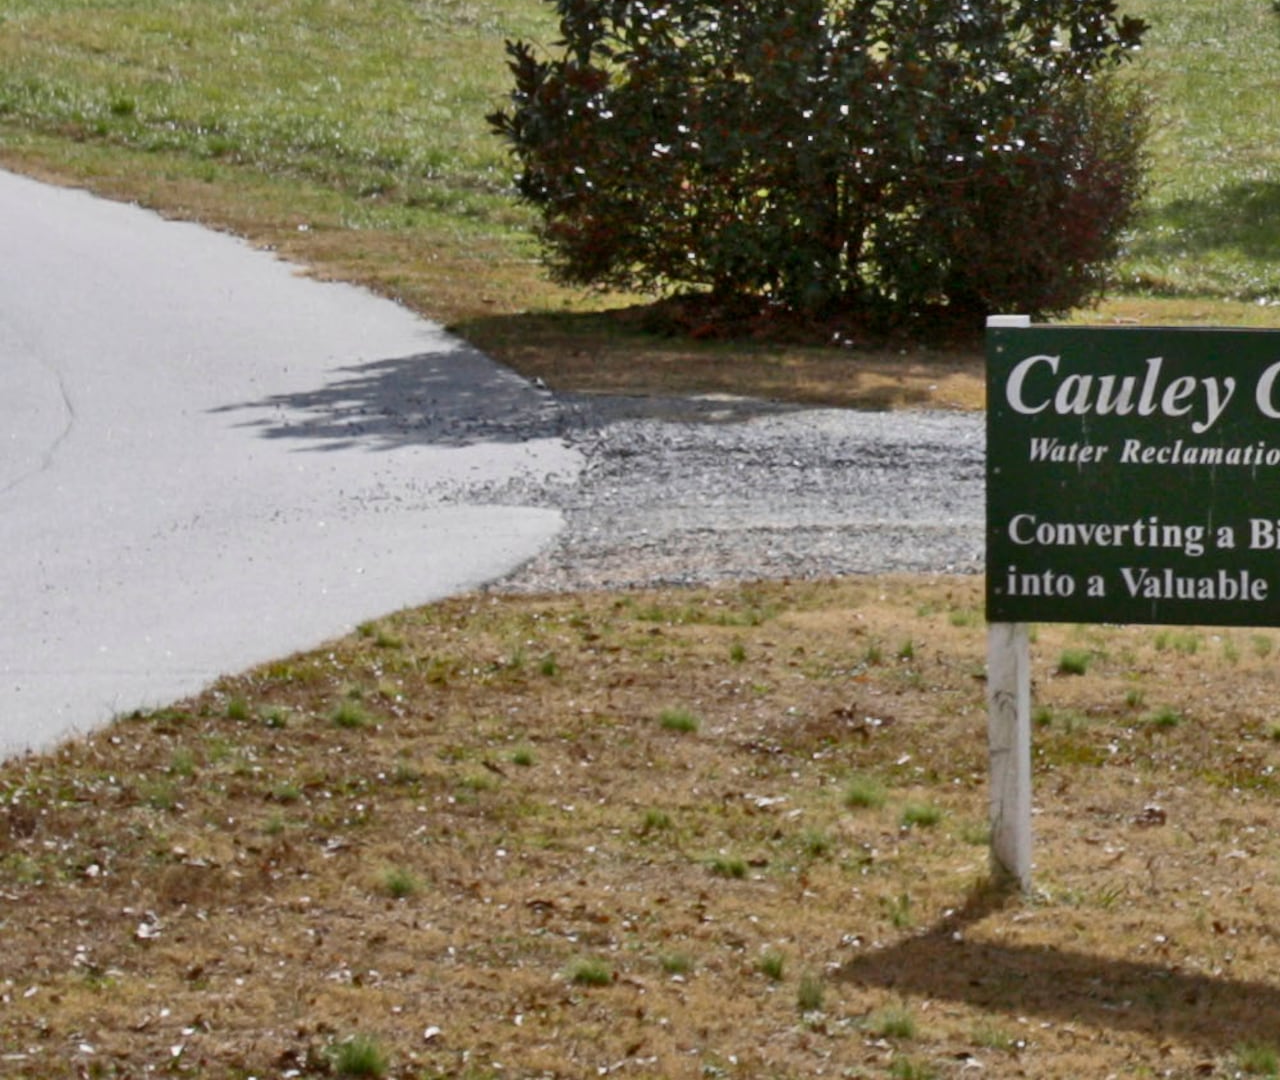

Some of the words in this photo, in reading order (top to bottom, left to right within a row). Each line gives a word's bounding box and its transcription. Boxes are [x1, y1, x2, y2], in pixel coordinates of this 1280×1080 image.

[1006, 355, 1235, 433] Cauley
[1031, 438, 1108, 465] Water
[1009, 514, 1204, 556] Converting
[1217, 527, 1234, 548] a
[1009, 566, 1074, 595] into
[1088, 576, 1104, 596] a
[1121, 568, 1267, 600] Valuable
